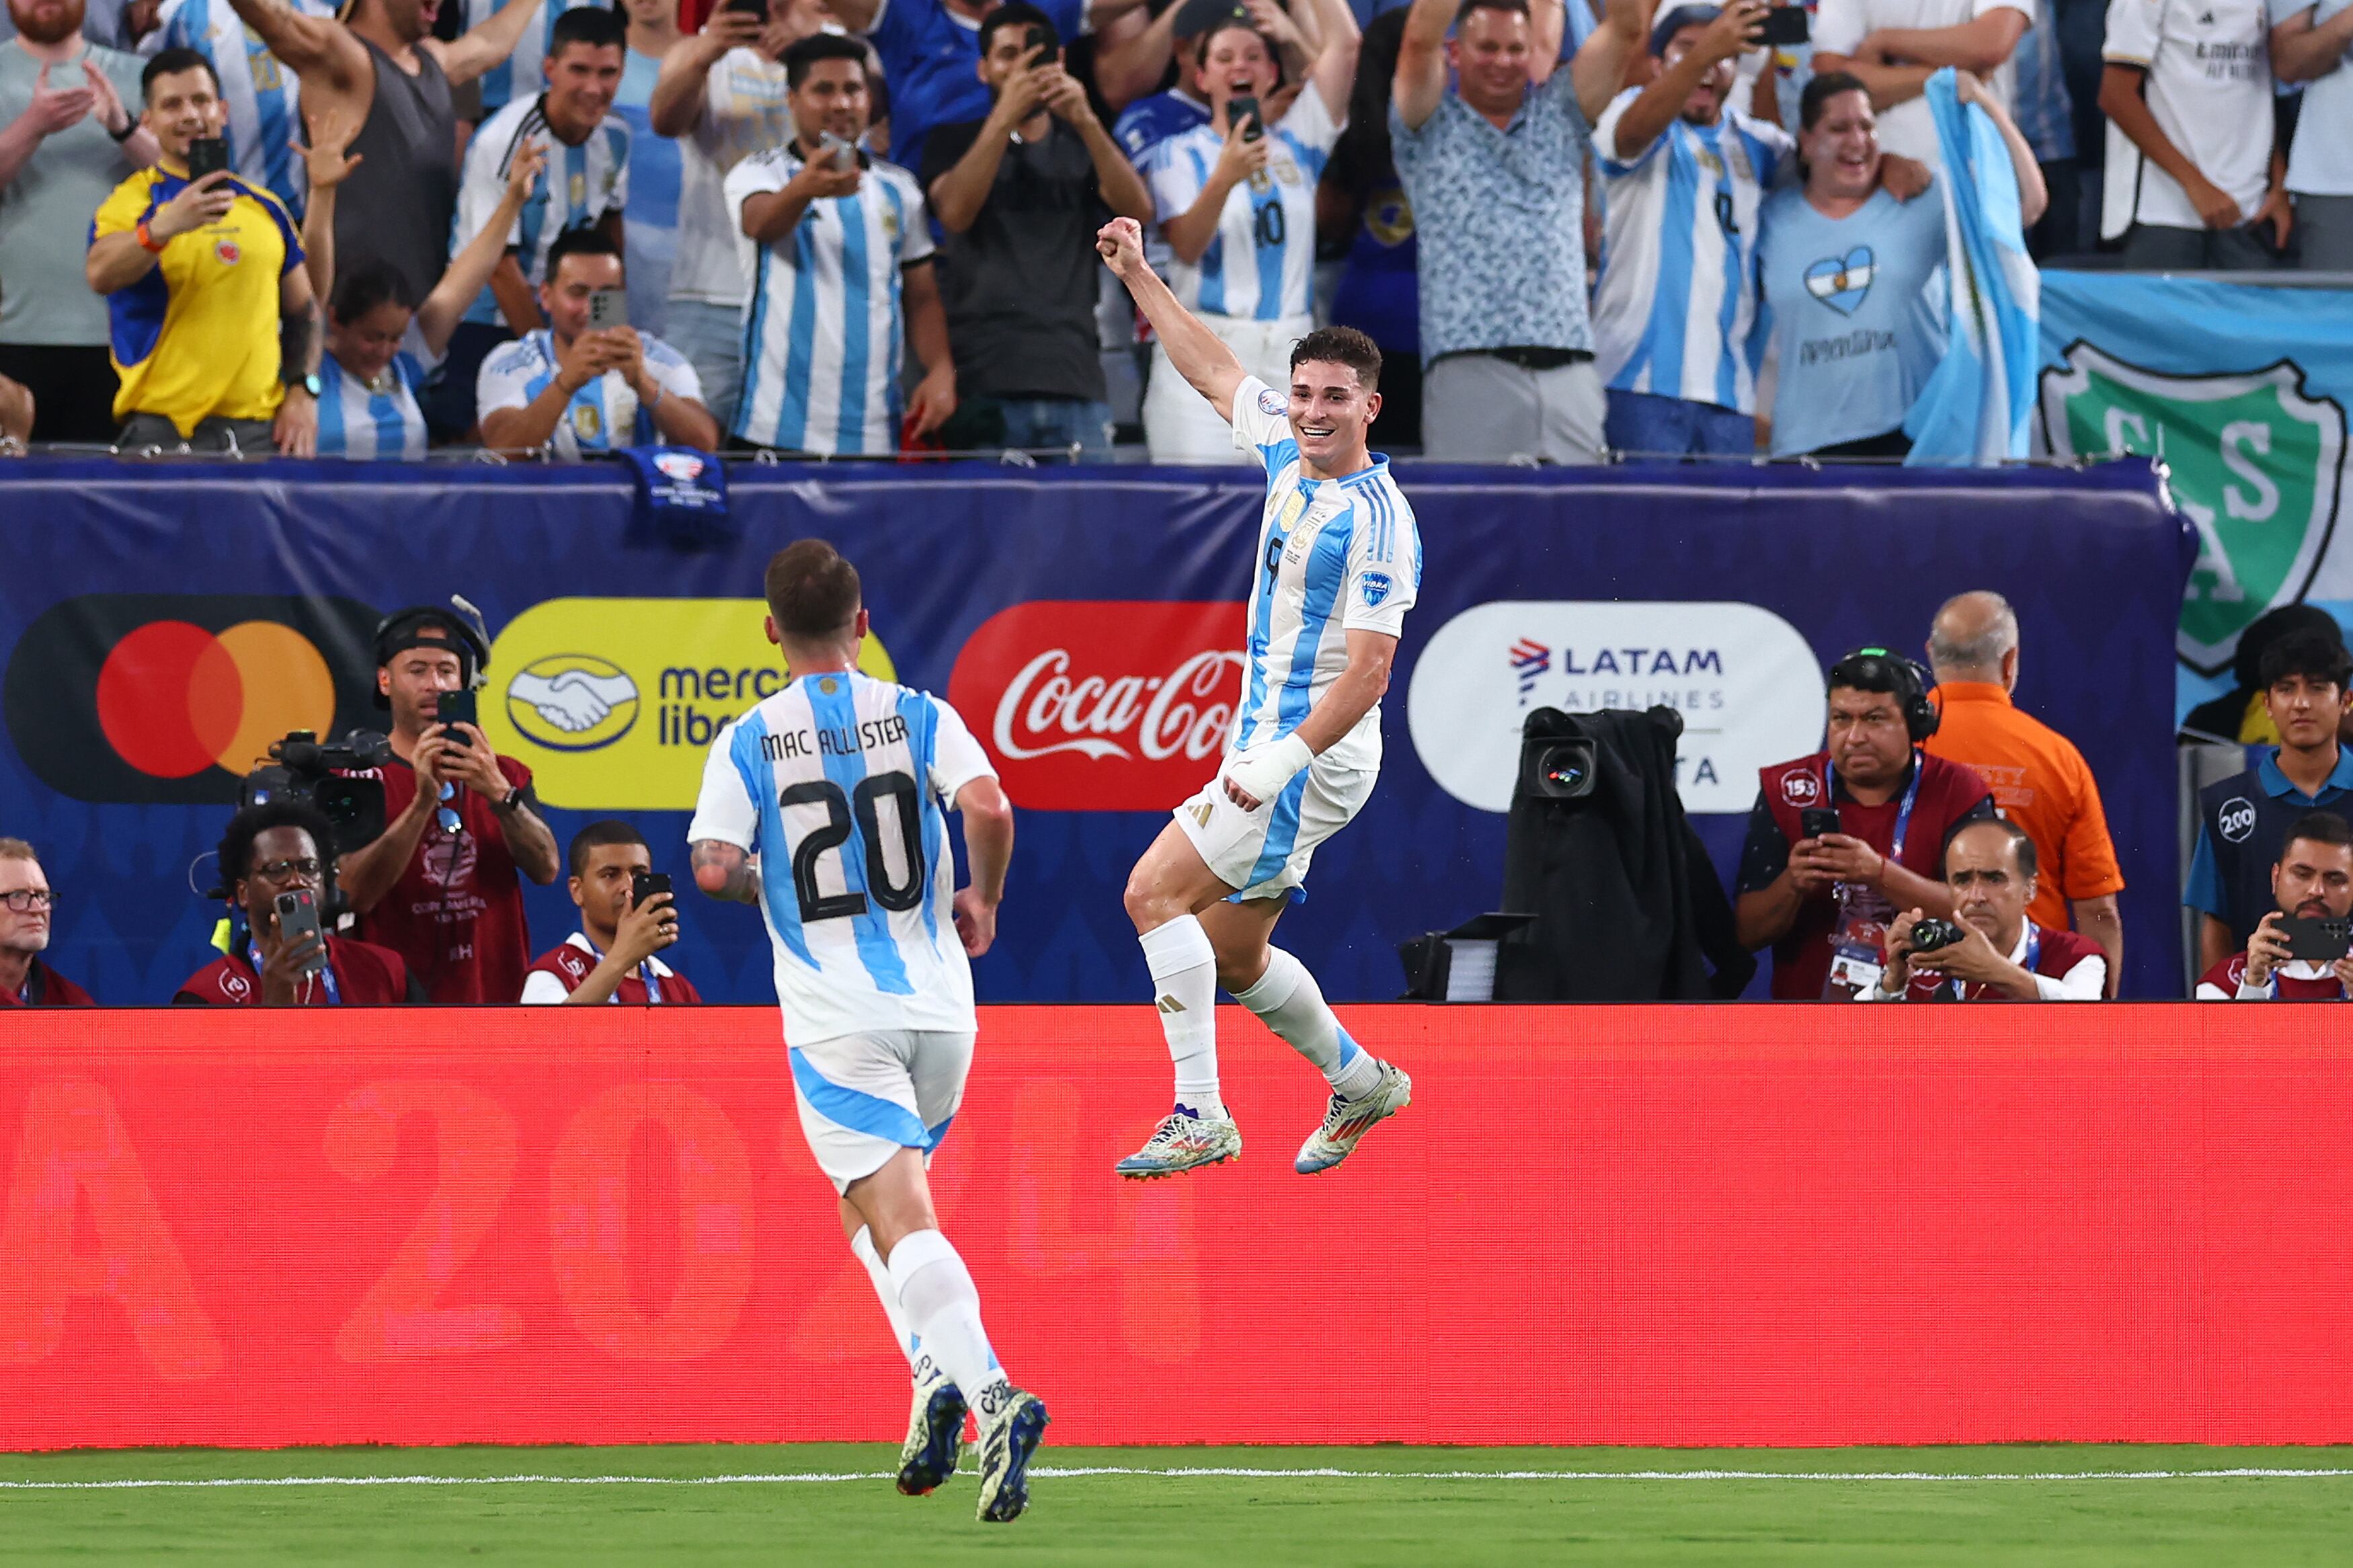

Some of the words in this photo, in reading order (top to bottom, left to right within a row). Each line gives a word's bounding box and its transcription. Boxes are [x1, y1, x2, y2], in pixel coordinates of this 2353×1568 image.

[1254, 202, 1285, 248] 10
[1564, 649, 1722, 674] LATAM
[660, 667, 791, 699] merc
[1564, 691, 1724, 708] AIRLINES
[993, 649, 1248, 760] Coca-Co
[760, 729, 812, 761] MAC
[817, 715, 910, 755] ALLISTER
[2221, 809, 2252, 833] 200
[780, 771, 926, 923] 20
